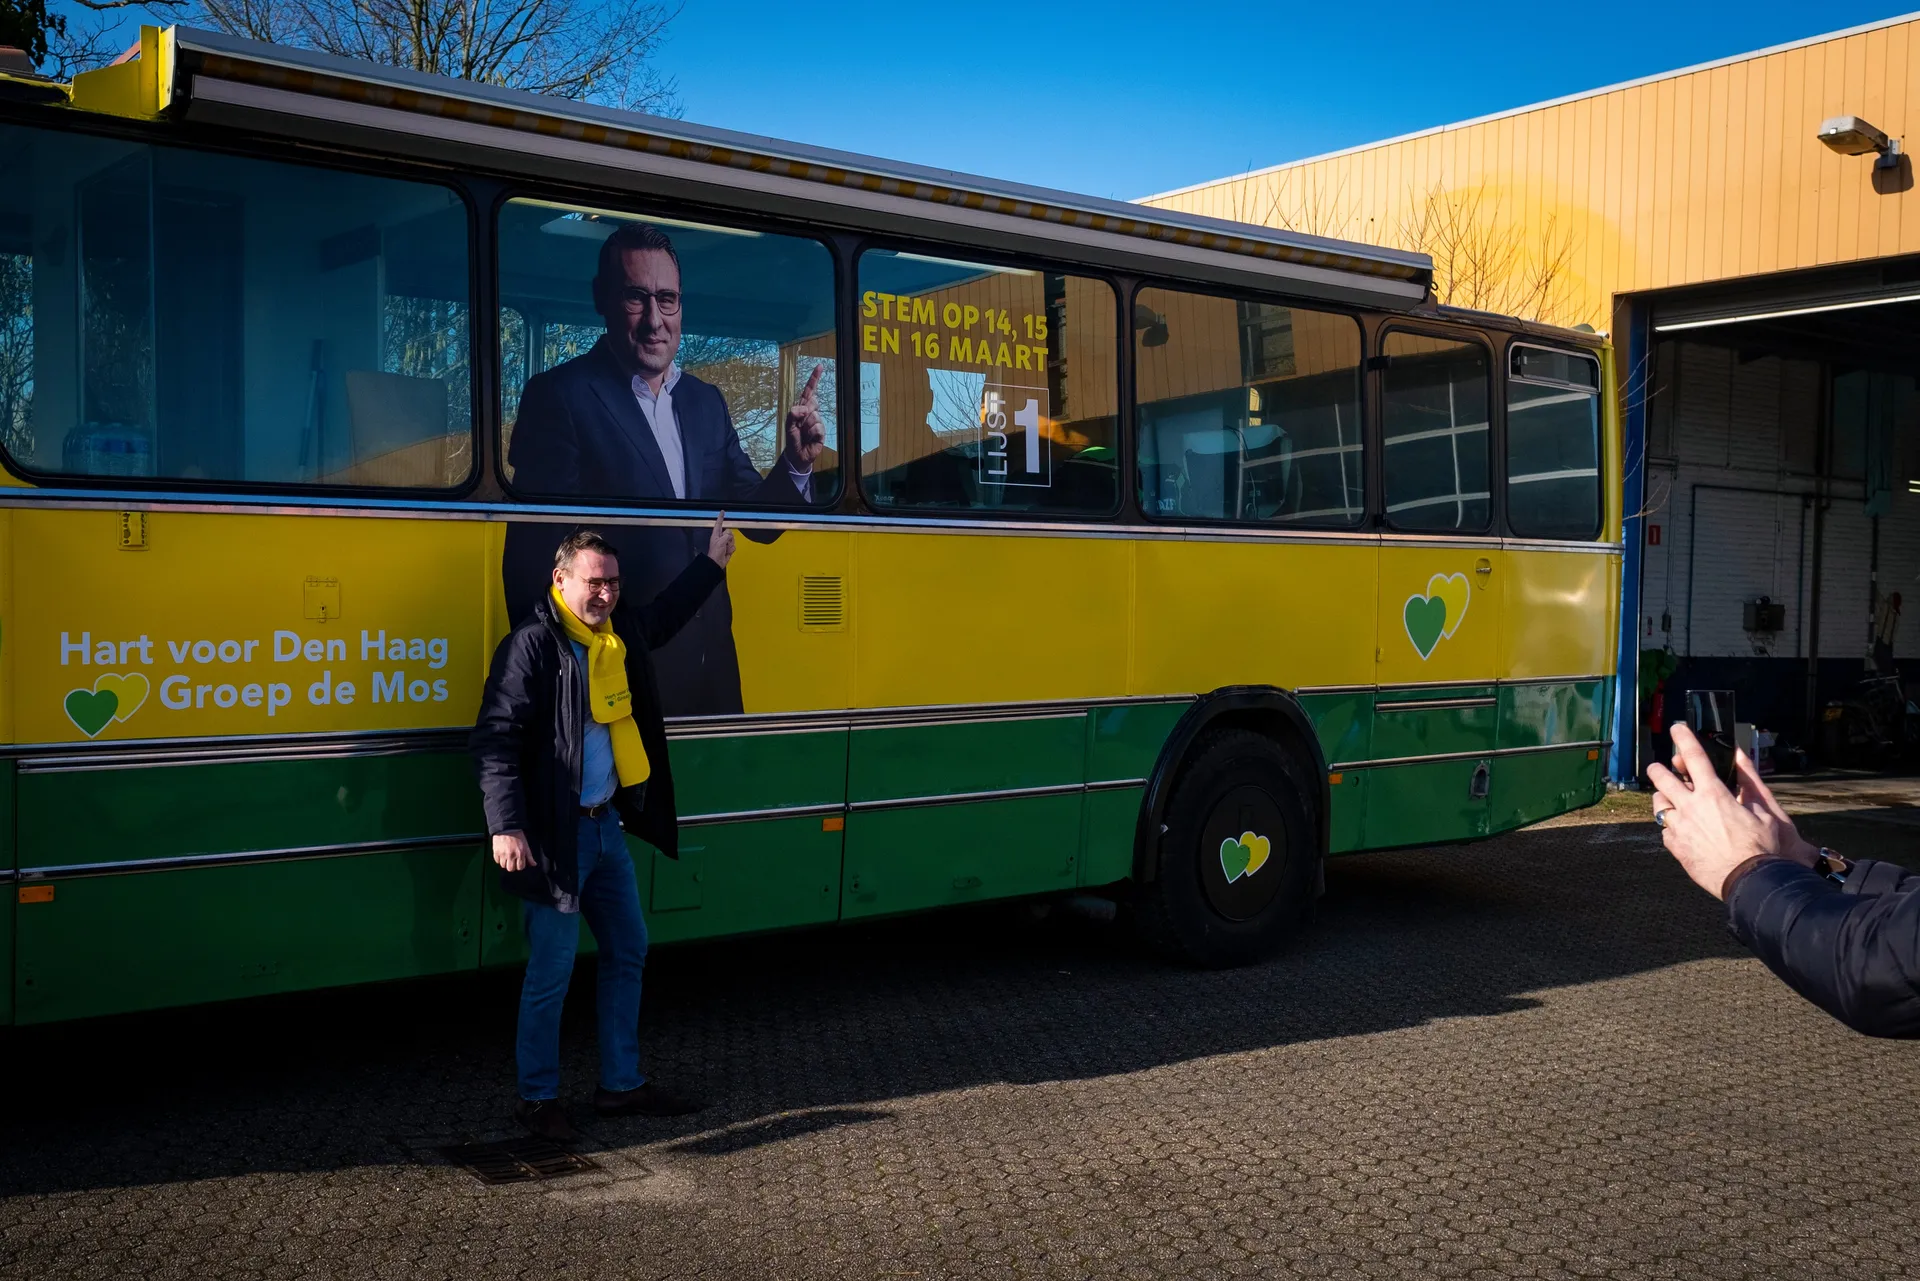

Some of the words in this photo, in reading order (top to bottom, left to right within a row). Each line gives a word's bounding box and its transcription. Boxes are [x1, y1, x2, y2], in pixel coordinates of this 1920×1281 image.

[863, 291, 936, 326] STEM
[943, 302, 980, 331] OP
[985, 308, 1018, 342] 14,
[1023, 313, 1048, 341] 15
[863, 324, 900, 355] EN
[911, 331, 940, 359] 16
[949, 335, 1049, 372] MAART
[986, 391, 1008, 475] LIJST
[1014, 398, 1040, 474] 1
[60, 631, 154, 665] Hart
[167, 639, 260, 664] voor
[273, 630, 347, 662] Den
[361, 629, 448, 669] Haag
[159, 674, 292, 717] Groep
[307, 670, 356, 706] de
[372, 670, 449, 703] Mos
